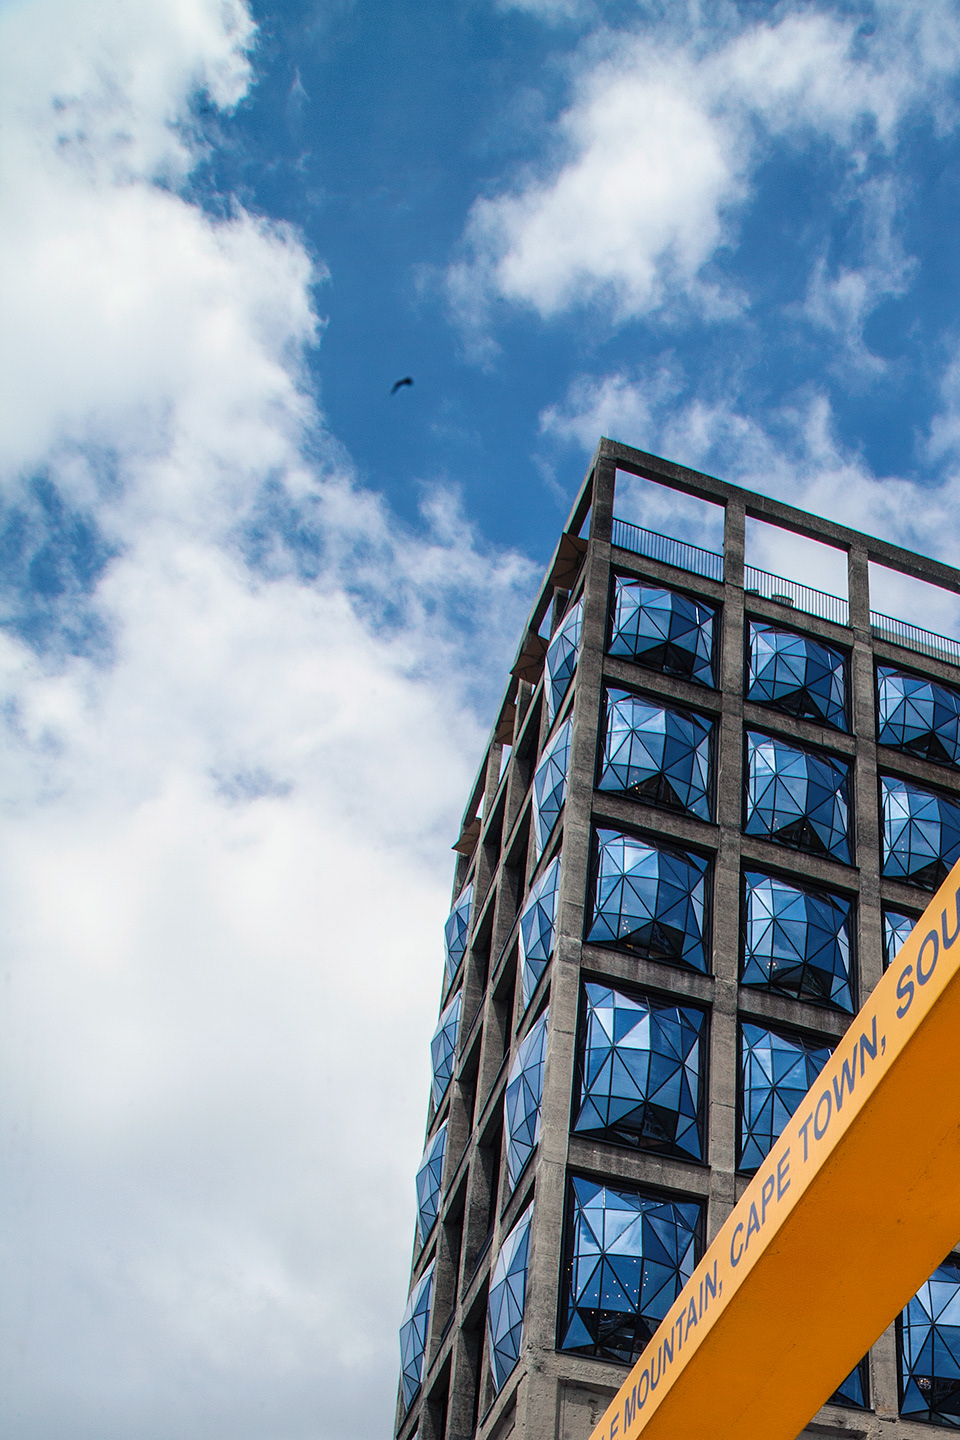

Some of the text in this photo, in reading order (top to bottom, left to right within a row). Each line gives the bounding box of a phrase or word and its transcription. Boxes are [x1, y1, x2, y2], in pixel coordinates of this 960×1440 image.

[623, 1259, 723, 1434] MOUNTAIN,
[730, 1147, 791, 1268] CAPE
[798, 1018, 887, 1163] TOWN,
